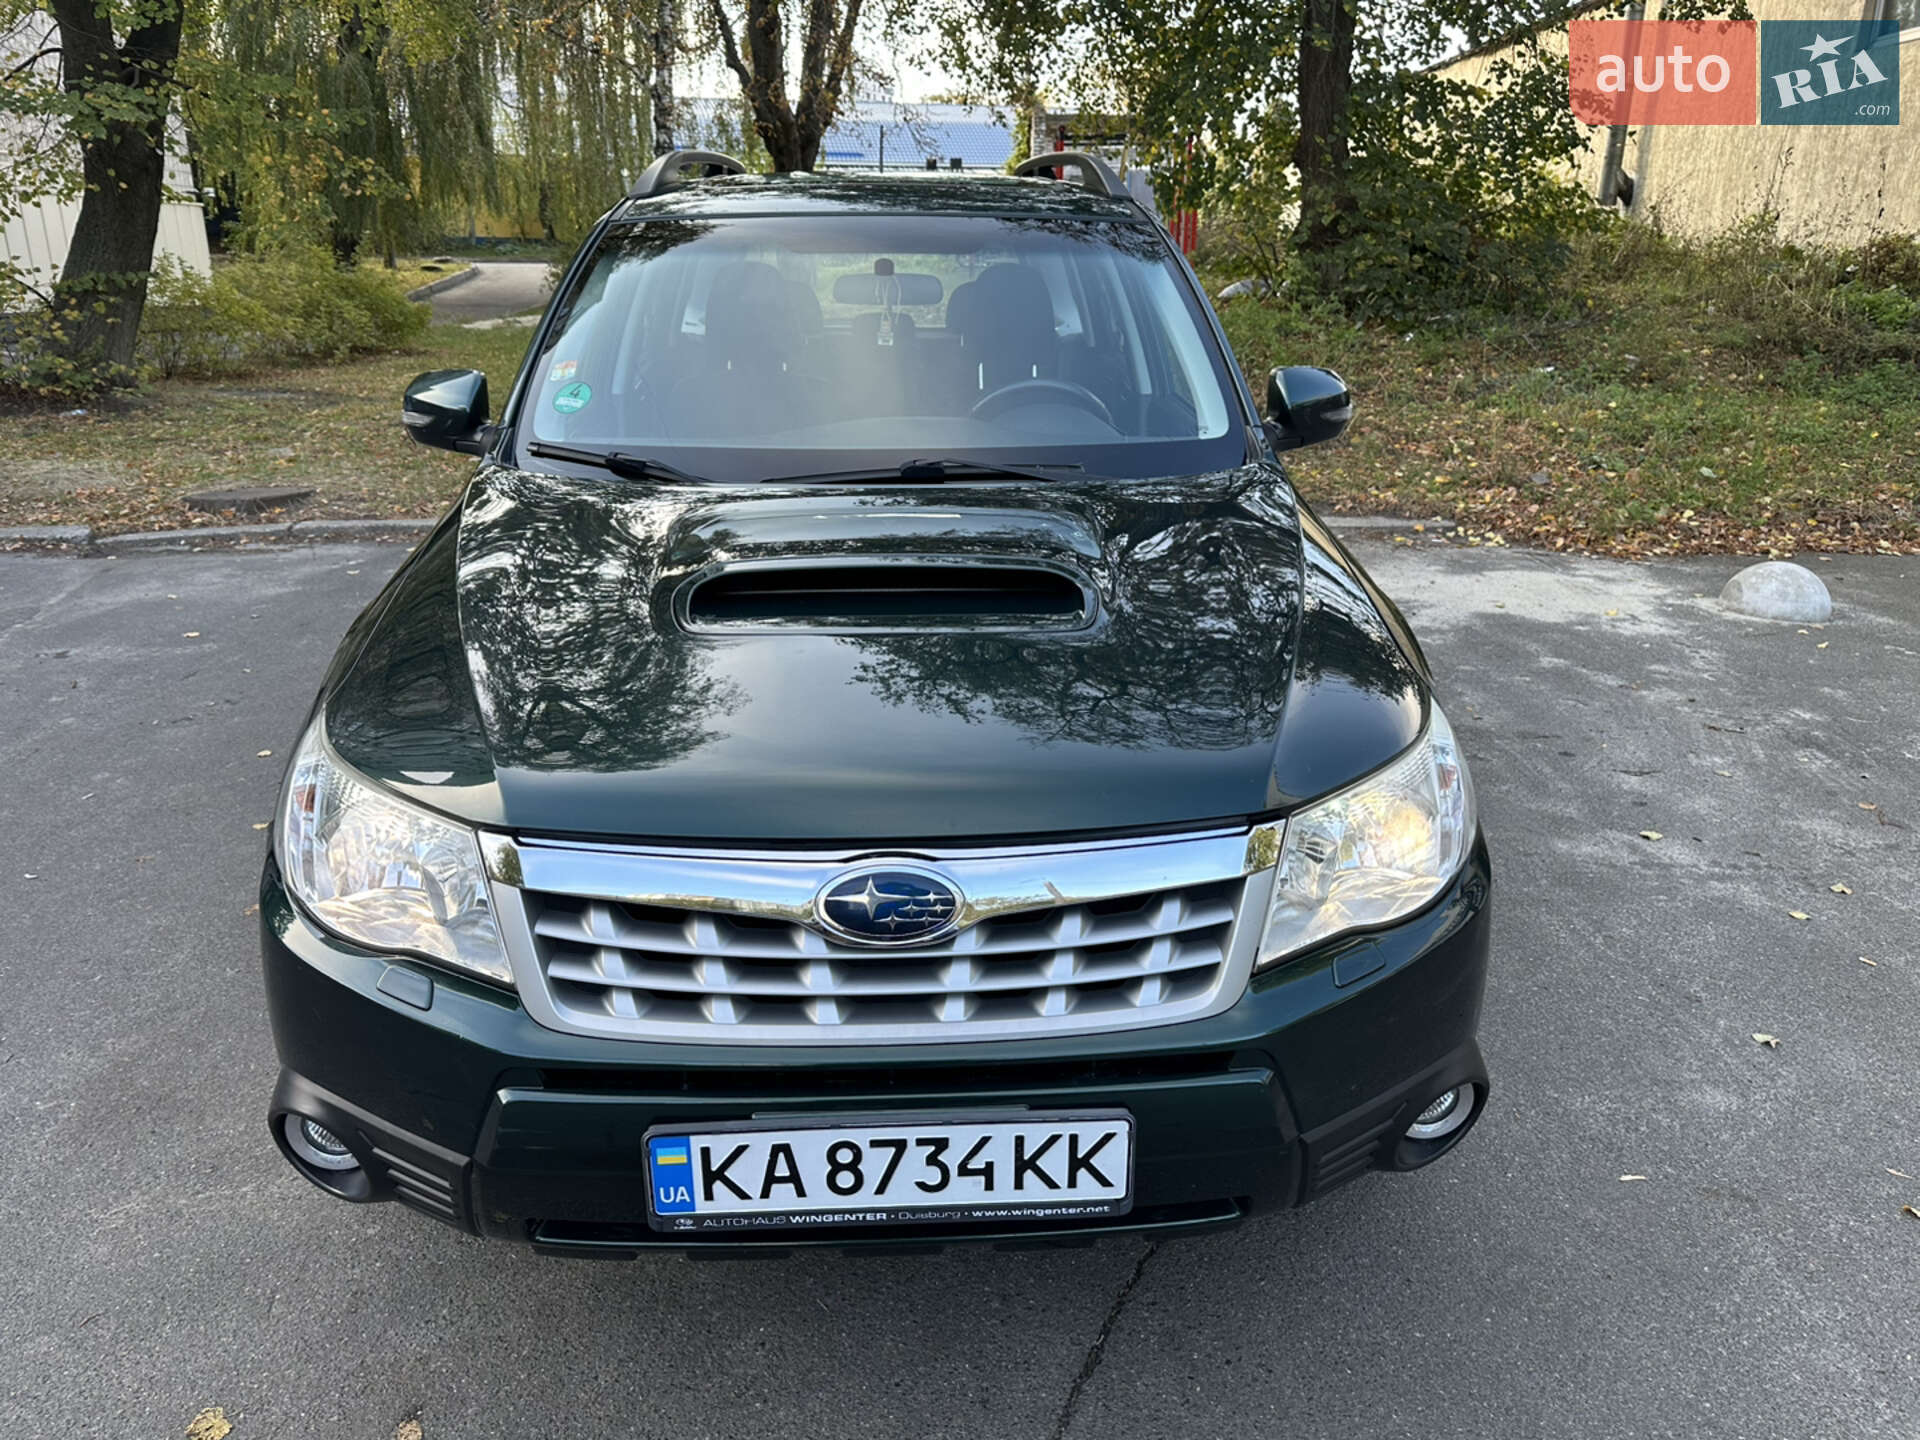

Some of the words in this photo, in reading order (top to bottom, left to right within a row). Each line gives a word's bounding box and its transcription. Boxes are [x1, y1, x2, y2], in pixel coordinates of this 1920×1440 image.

[569, 383, 583, 398] 4
[700, 1143, 807, 1201] KA
[826, 1135, 995, 1196] 8734
[1013, 1131, 1117, 1190] KK
[660, 1186, 691, 1204] UA
[703, 1215, 786, 1227] AUTOHAUS
[789, 1211, 887, 1224] WINGENTER
[899, 1209, 961, 1221] Duisburg
[971, 1205, 1110, 1217] www.wingenter.net
